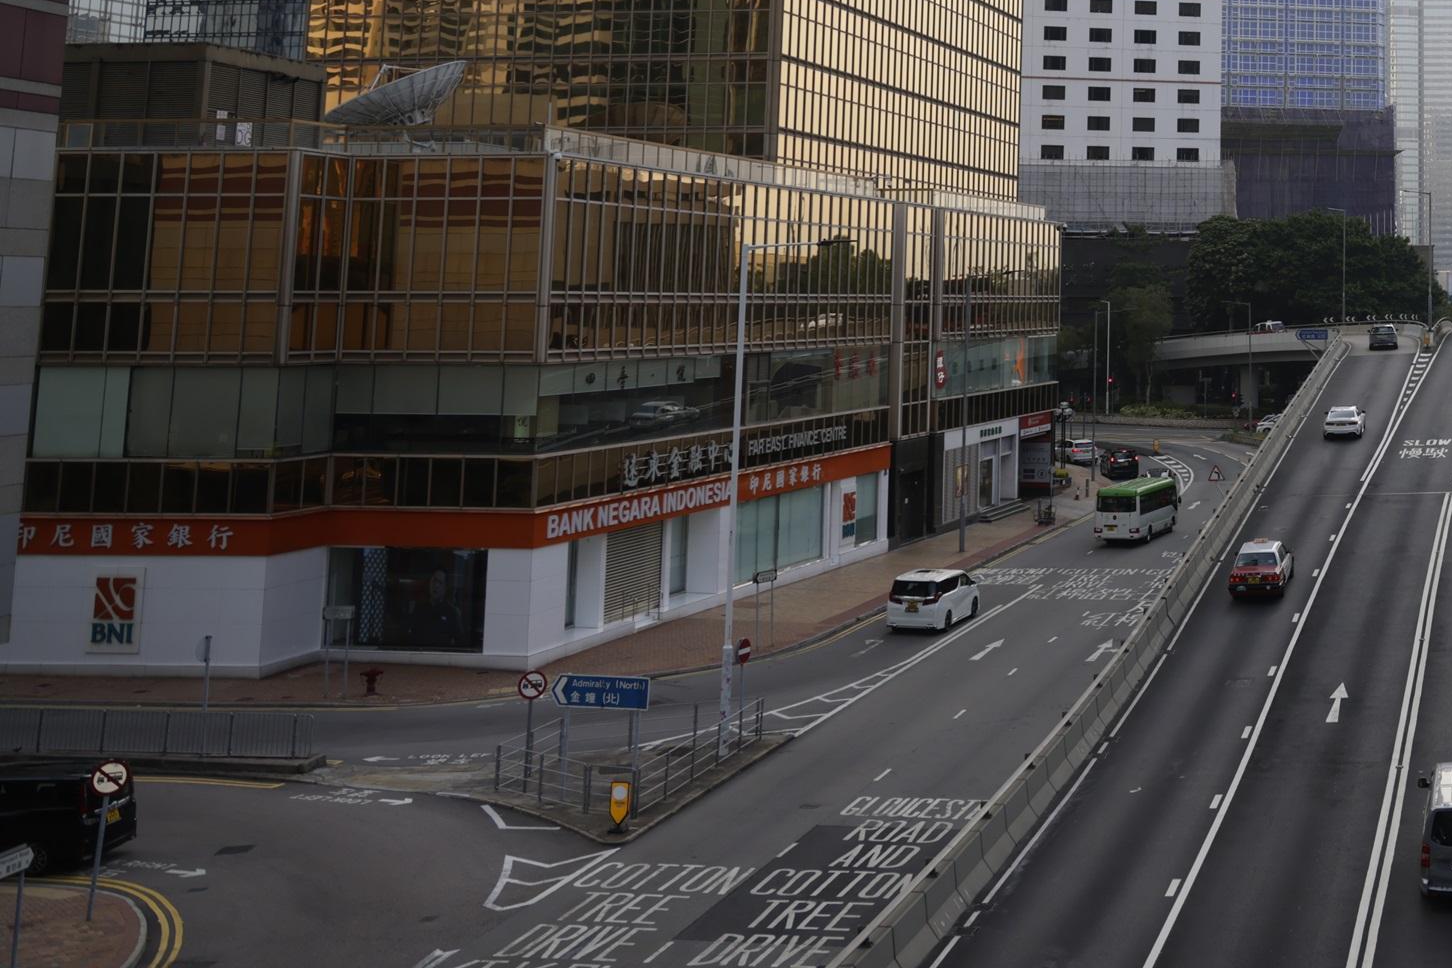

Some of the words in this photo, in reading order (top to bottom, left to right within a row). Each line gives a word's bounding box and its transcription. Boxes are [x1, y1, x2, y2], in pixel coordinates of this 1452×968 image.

[748, 438, 766, 456] FAR
[766, 433, 789, 452] EAST
[789, 428, 820, 450] FINANCE
[821, 425, 847, 443] CENTRE
[1399, 447, 1448, 459] 慢駛
[1403, 438, 1452, 447] SLOW
[750, 463, 822, 496] 印尼國家銀行
[546, 507, 596, 539] BANK
[597, 495, 662, 529] NEGARA
[662, 480, 733, 514] INDONESIA
[91, 622, 135, 644] BNI
[571, 678, 612, 690] Admiralty
[615, 679, 646, 691] (North)
[842, 819, 956, 844] ROAD
[828, 844, 922, 869] AND
[573, 862, 756, 895] COTTON
[557, 891, 691, 924] TREE
[747, 899, 876, 932] TREE
[492, 923, 659, 962] DRIVE
[686, 933, 846, 968] DRIVE
